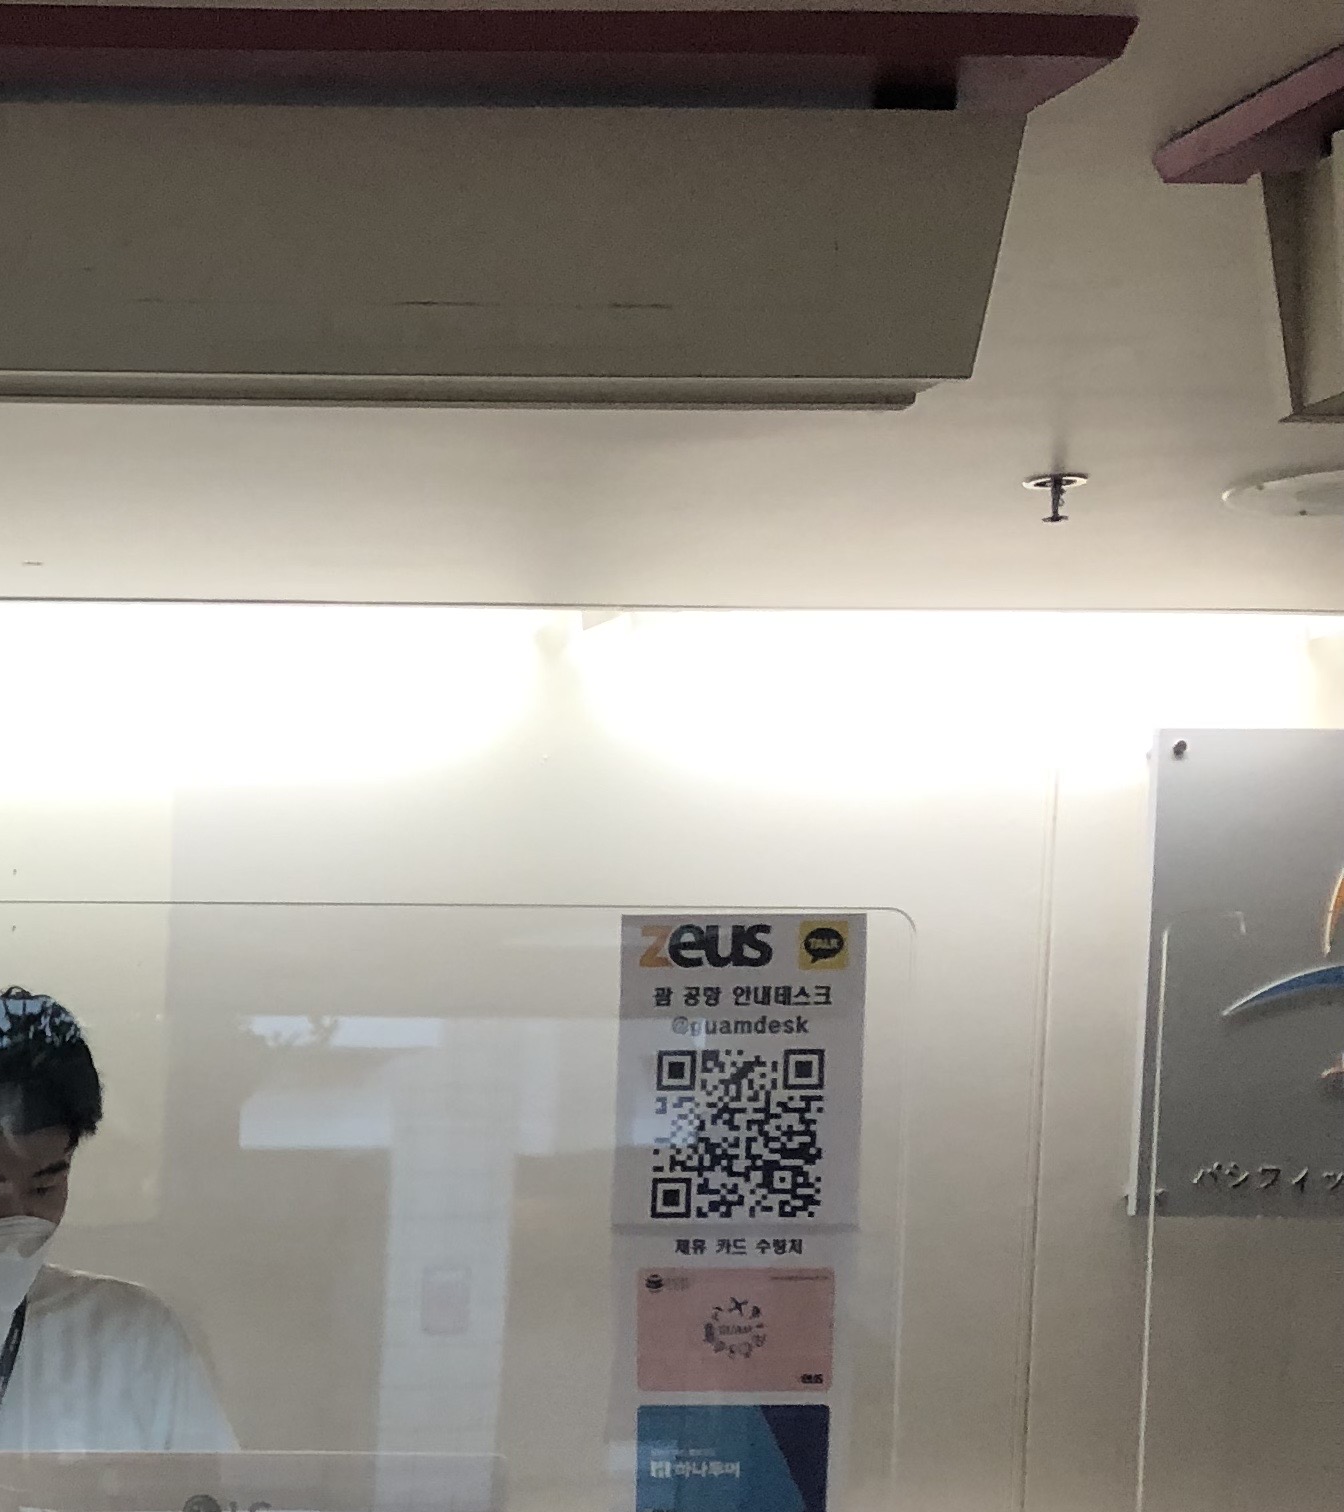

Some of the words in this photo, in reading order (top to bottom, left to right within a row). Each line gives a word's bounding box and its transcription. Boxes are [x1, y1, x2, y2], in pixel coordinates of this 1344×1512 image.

[683, 986, 722, 1007] 공항
[732, 985, 833, 1006] 안내데스크
[671, 1015, 809, 1037] @guamdesk
[715, 1238, 747, 1256] 카드
